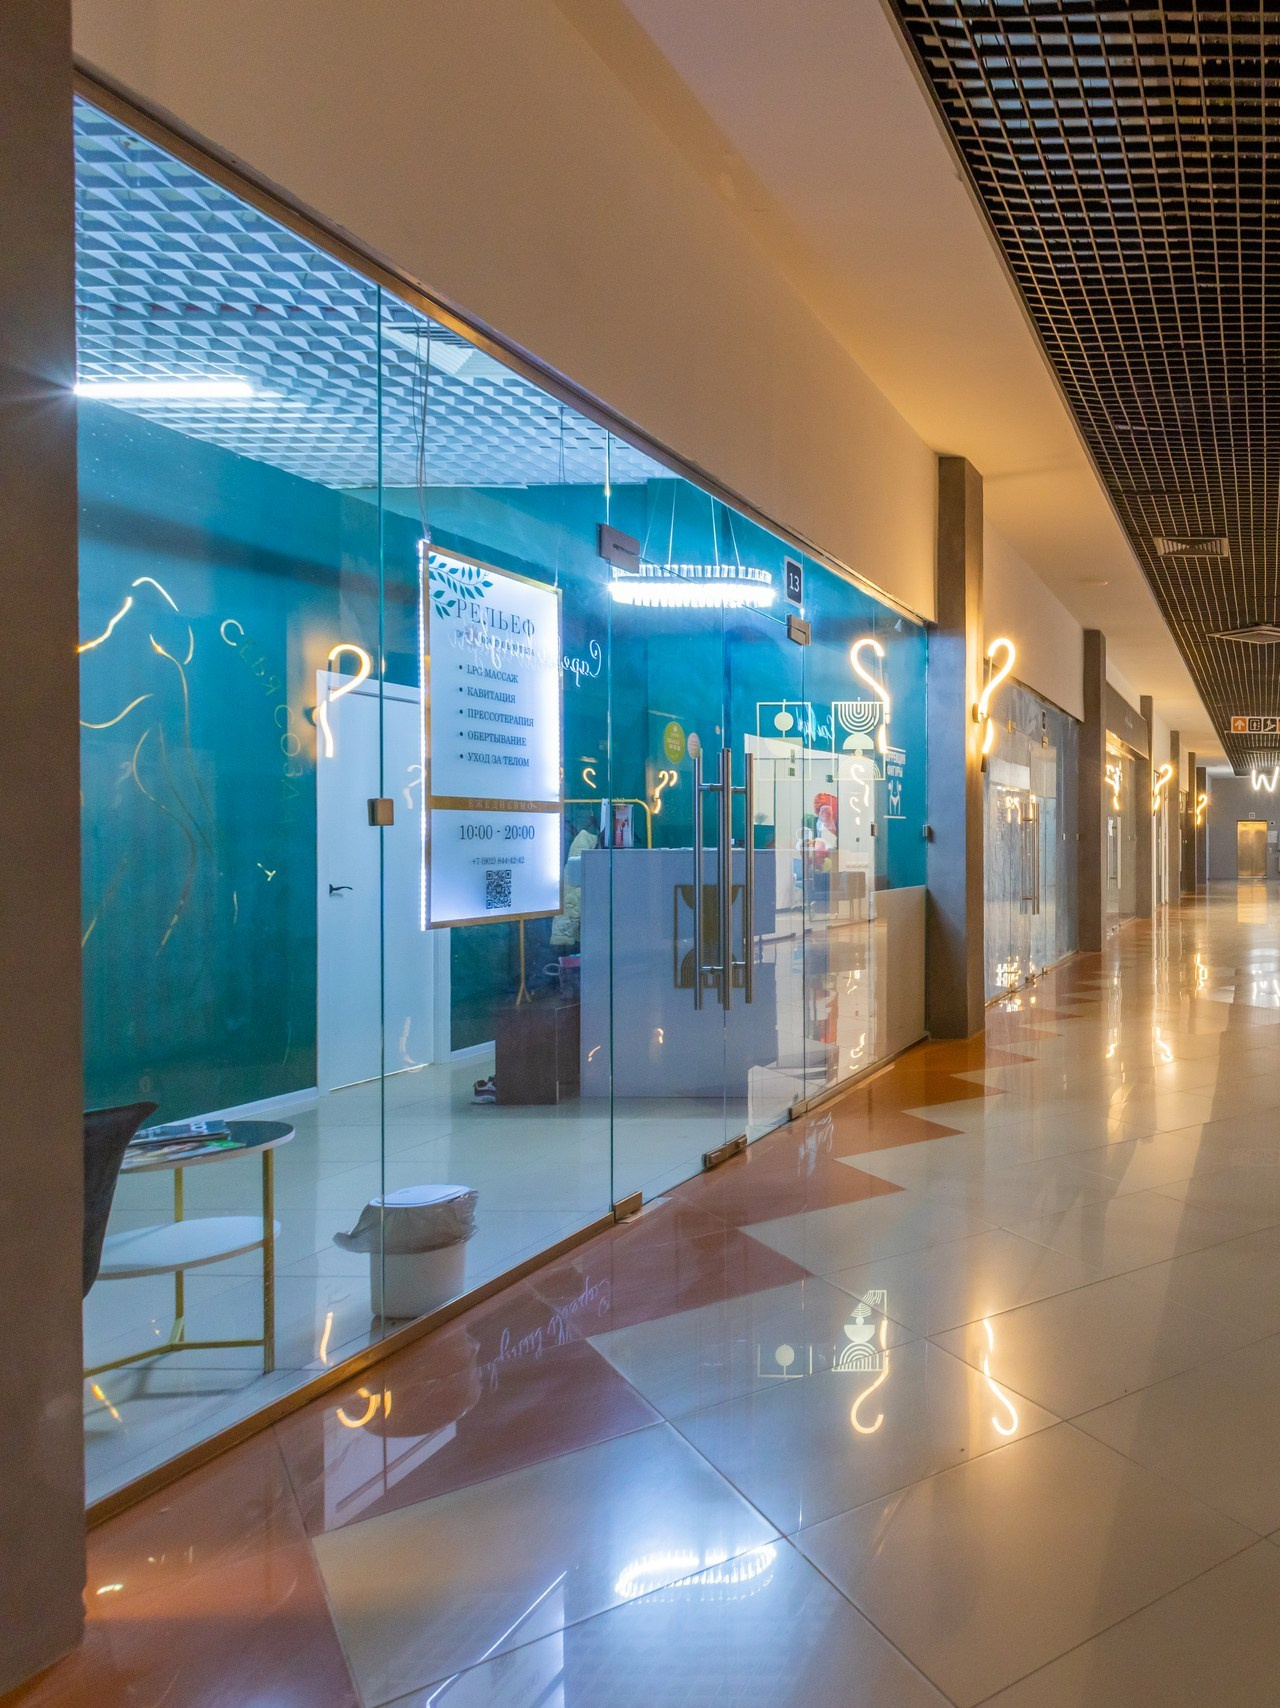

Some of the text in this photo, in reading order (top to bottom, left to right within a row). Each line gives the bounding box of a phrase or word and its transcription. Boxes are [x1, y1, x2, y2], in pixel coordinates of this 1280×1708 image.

[789, 572, 800, 593] 13
[456, 598, 535, 637] РЕЛЬЕФ
[467, 664, 519, 684] LPG МАССАЖ
[467, 686, 516, 704] КАВИТАЦИЯ
[467, 708, 534, 728] ПРЕССОТЕРАПИЯ
[467, 730, 527, 747] ОБЕРТЫВАНИЕ
[467, 752, 530, 767] УХОД ЗА ТЕЛОМ
[468, 799, 534, 810] ЕЖЕДНЕВНО
[460, 824, 493, 840] 10:00
[504, 825, 535, 840] 20:00
